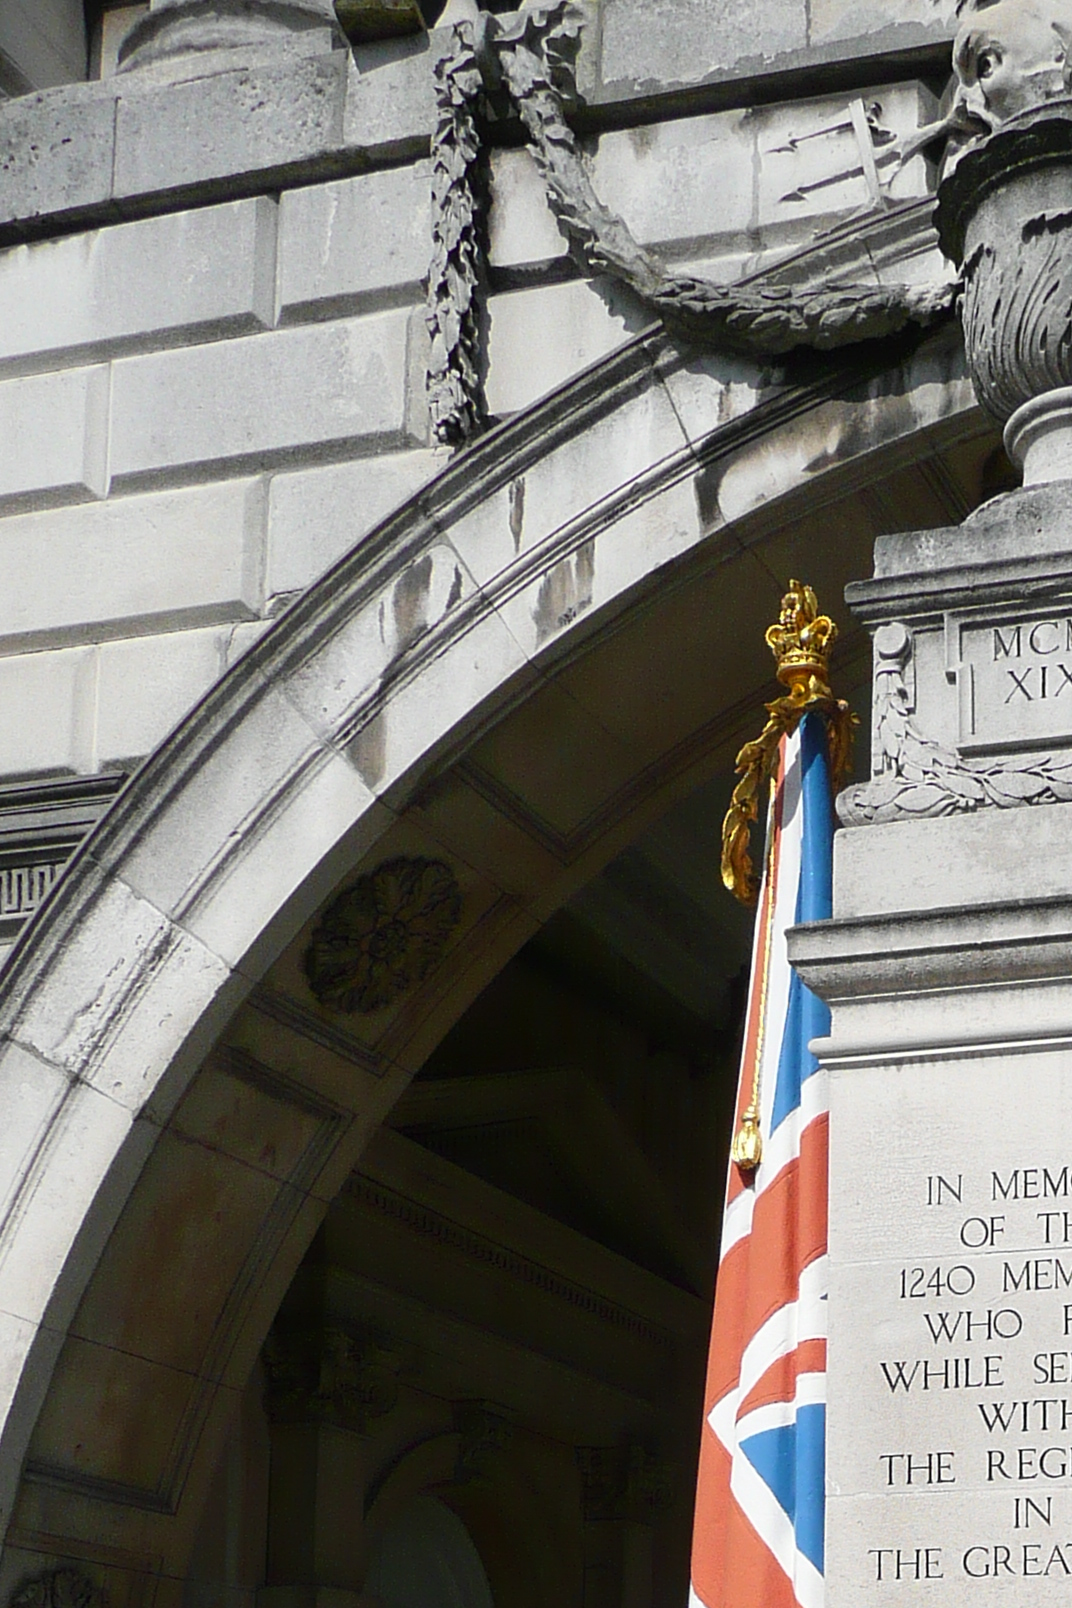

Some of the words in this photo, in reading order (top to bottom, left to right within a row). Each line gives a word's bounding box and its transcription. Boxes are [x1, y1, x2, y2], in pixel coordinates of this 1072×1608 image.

[927, 1174, 963, 1205] IN
[960, 1216, 1005, 1247] OF
[900, 1265, 975, 1298] 1240
[923, 1309, 1022, 1344] WHO
[880, 1355, 1004, 1393] WHILE
[880, 1452, 955, 1485] THE
[1013, 1497, 1052, 1528] IN
[868, 1549, 943, 1580] THE
